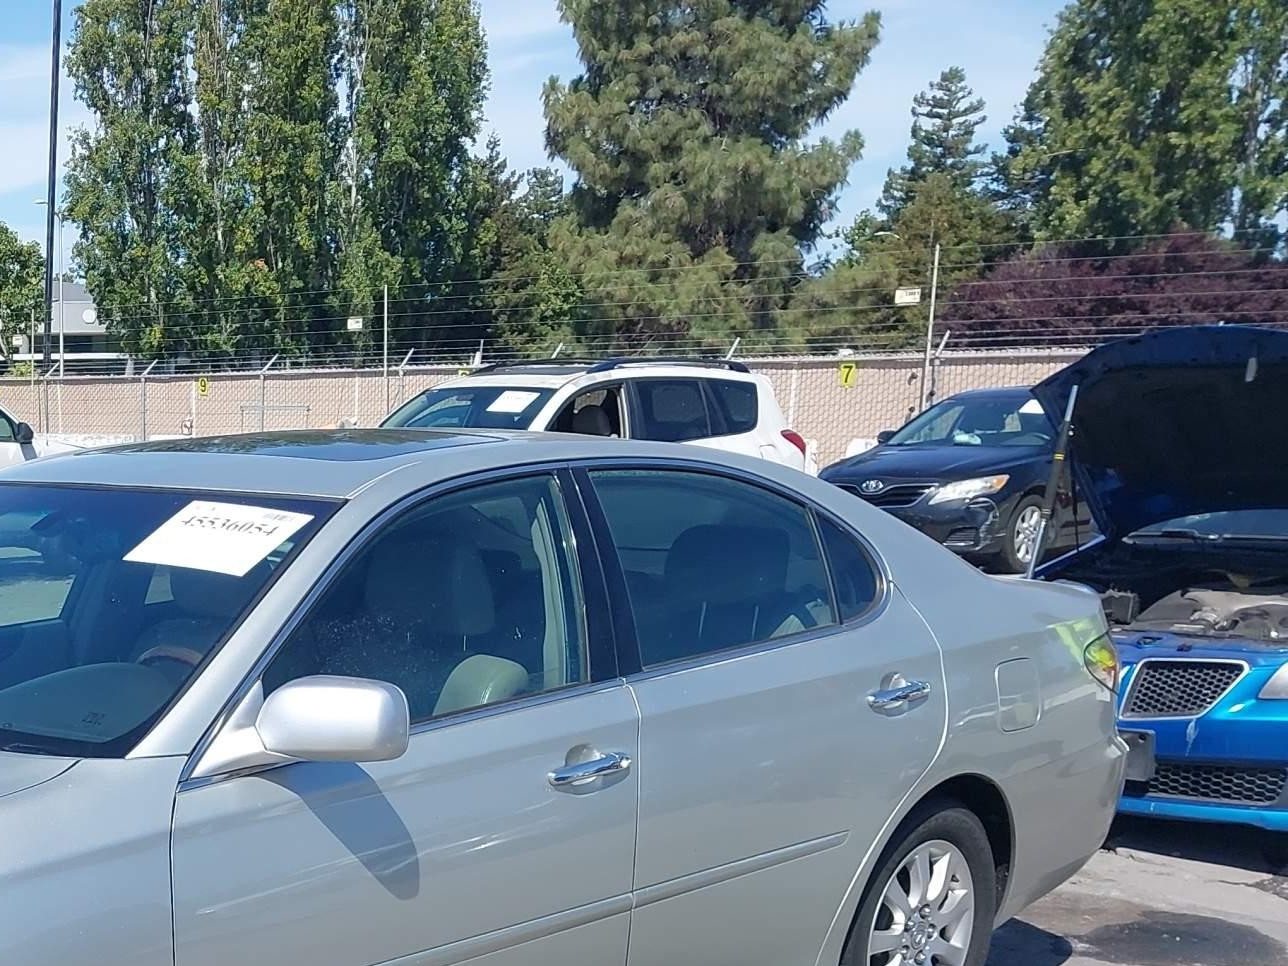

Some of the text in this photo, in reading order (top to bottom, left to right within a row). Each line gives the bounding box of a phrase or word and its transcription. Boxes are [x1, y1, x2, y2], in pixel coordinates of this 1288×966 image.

[843, 365, 854, 383] 7
[200, 378, 206, 393] 9
[181, 515, 279, 536] 45536054
